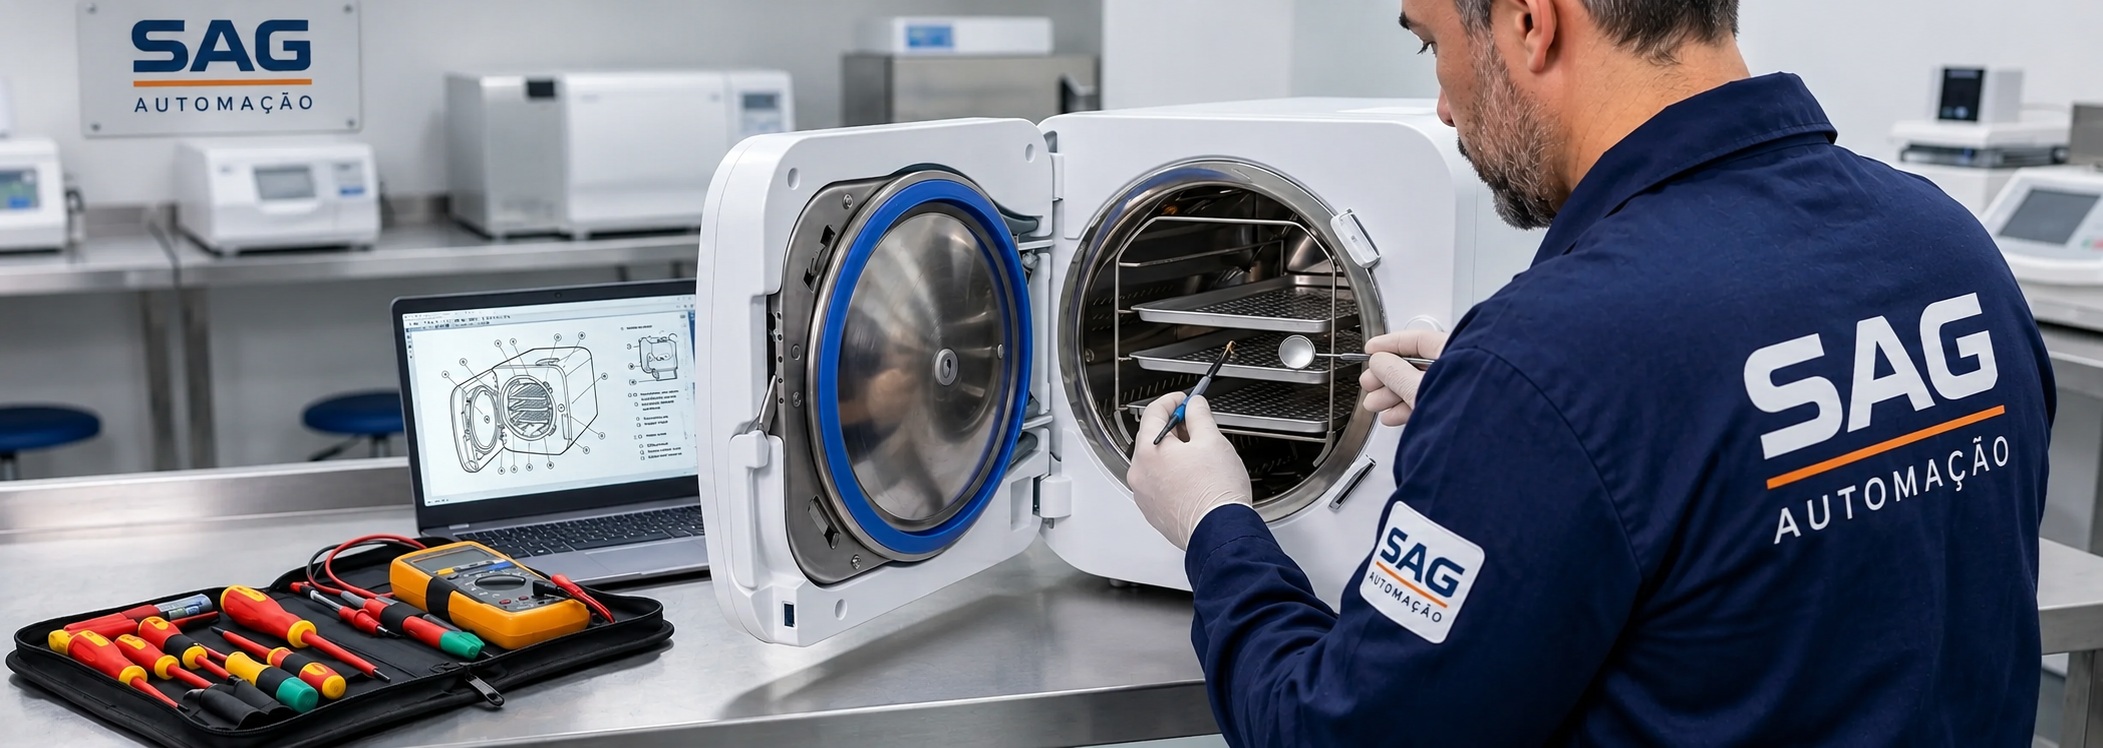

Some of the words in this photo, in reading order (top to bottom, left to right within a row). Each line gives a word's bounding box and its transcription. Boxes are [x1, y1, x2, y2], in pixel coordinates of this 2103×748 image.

[131, 19, 312, 73] SAG
[134, 91, 313, 115] AUTOMAÇÃO
[1743, 292, 1999, 460] SAG
[1774, 436, 2009, 545] AUTOMAÇÃO
[1379, 526, 1466, 598] SAG
[1369, 571, 1442, 623] AUTOMAÇÃO
